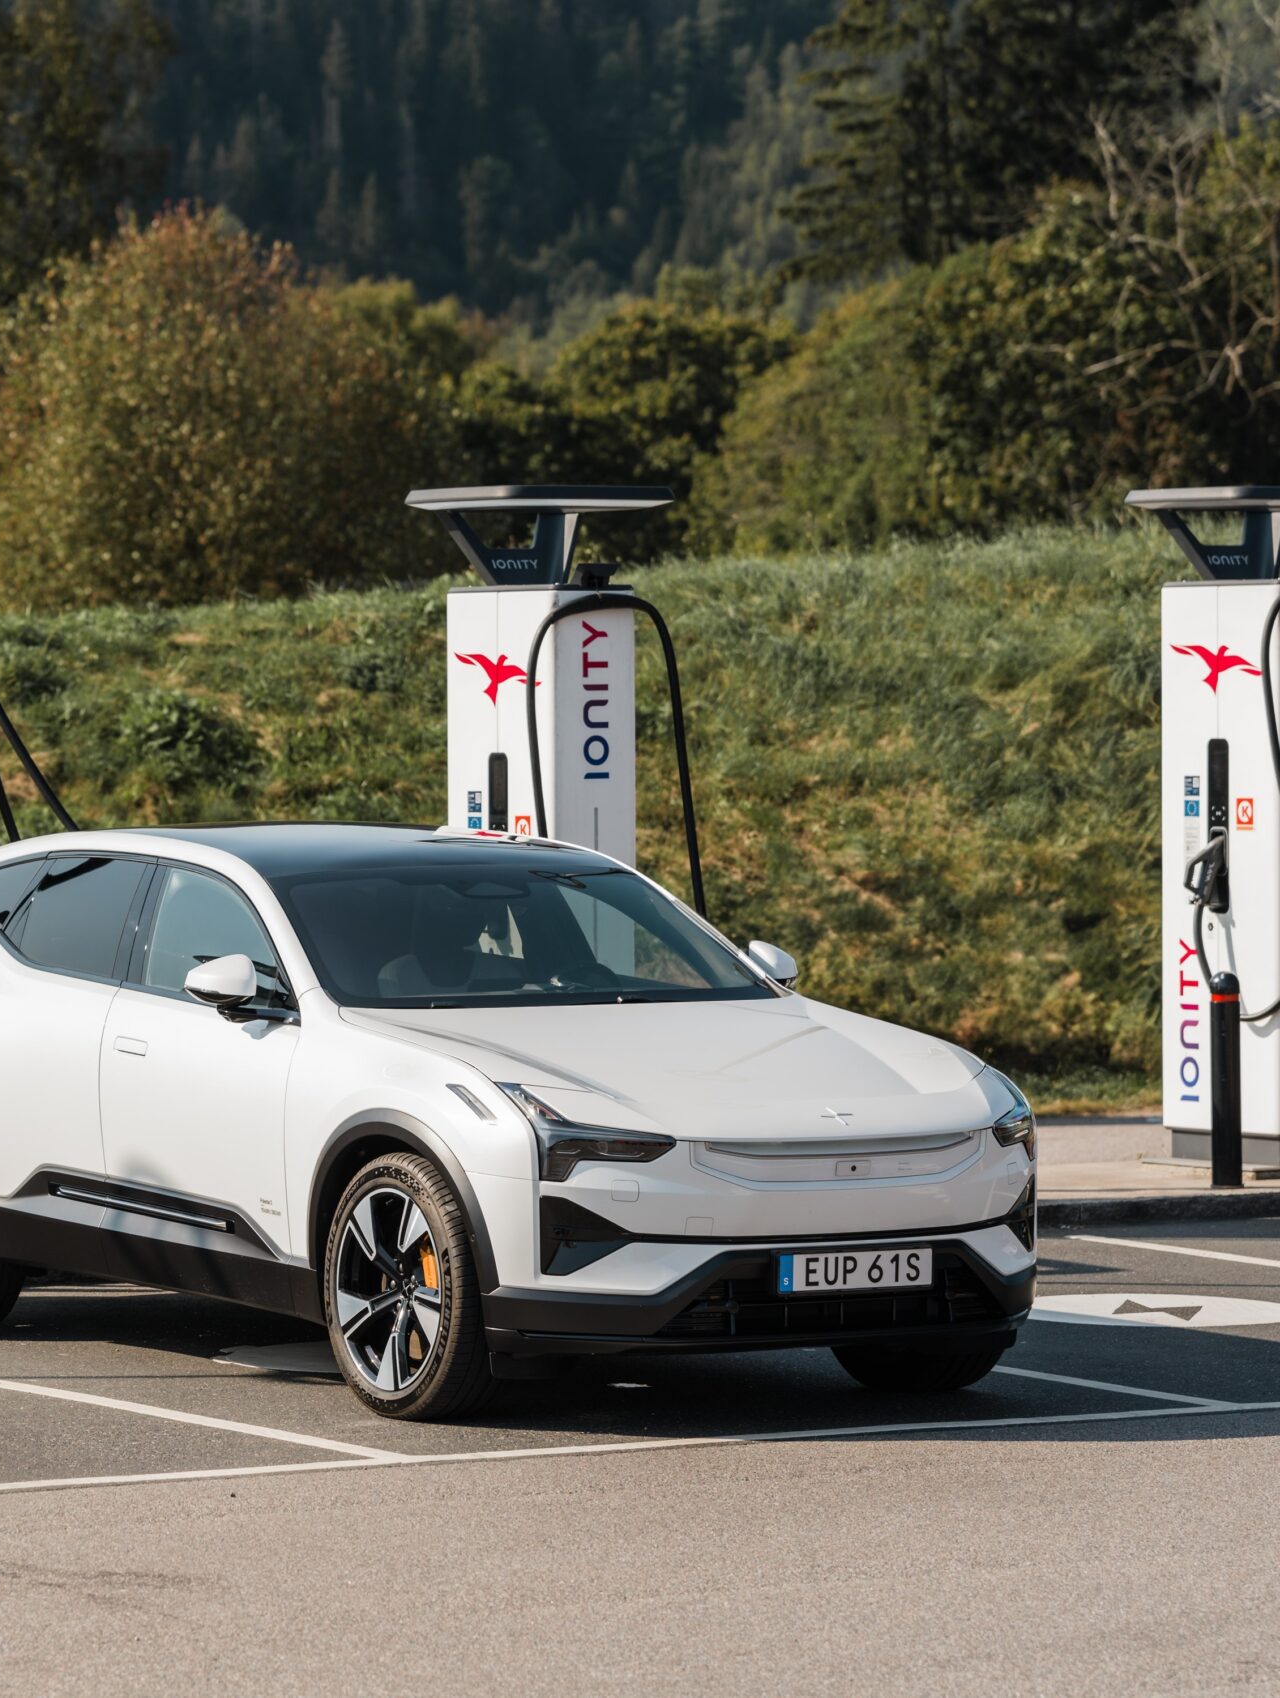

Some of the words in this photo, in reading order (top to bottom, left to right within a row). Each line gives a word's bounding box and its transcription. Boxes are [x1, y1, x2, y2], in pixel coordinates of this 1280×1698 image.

[492, 559, 538, 570] IONITY
[581, 620, 610, 780] IONITY
[1179, 938, 1200, 1102] IONITY
[783, 1277, 789, 1285] S
[805, 1255, 858, 1287] EUP
[867, 1252, 920, 1283] 61S
[438, 1275, 452, 1357] MICHELIN
